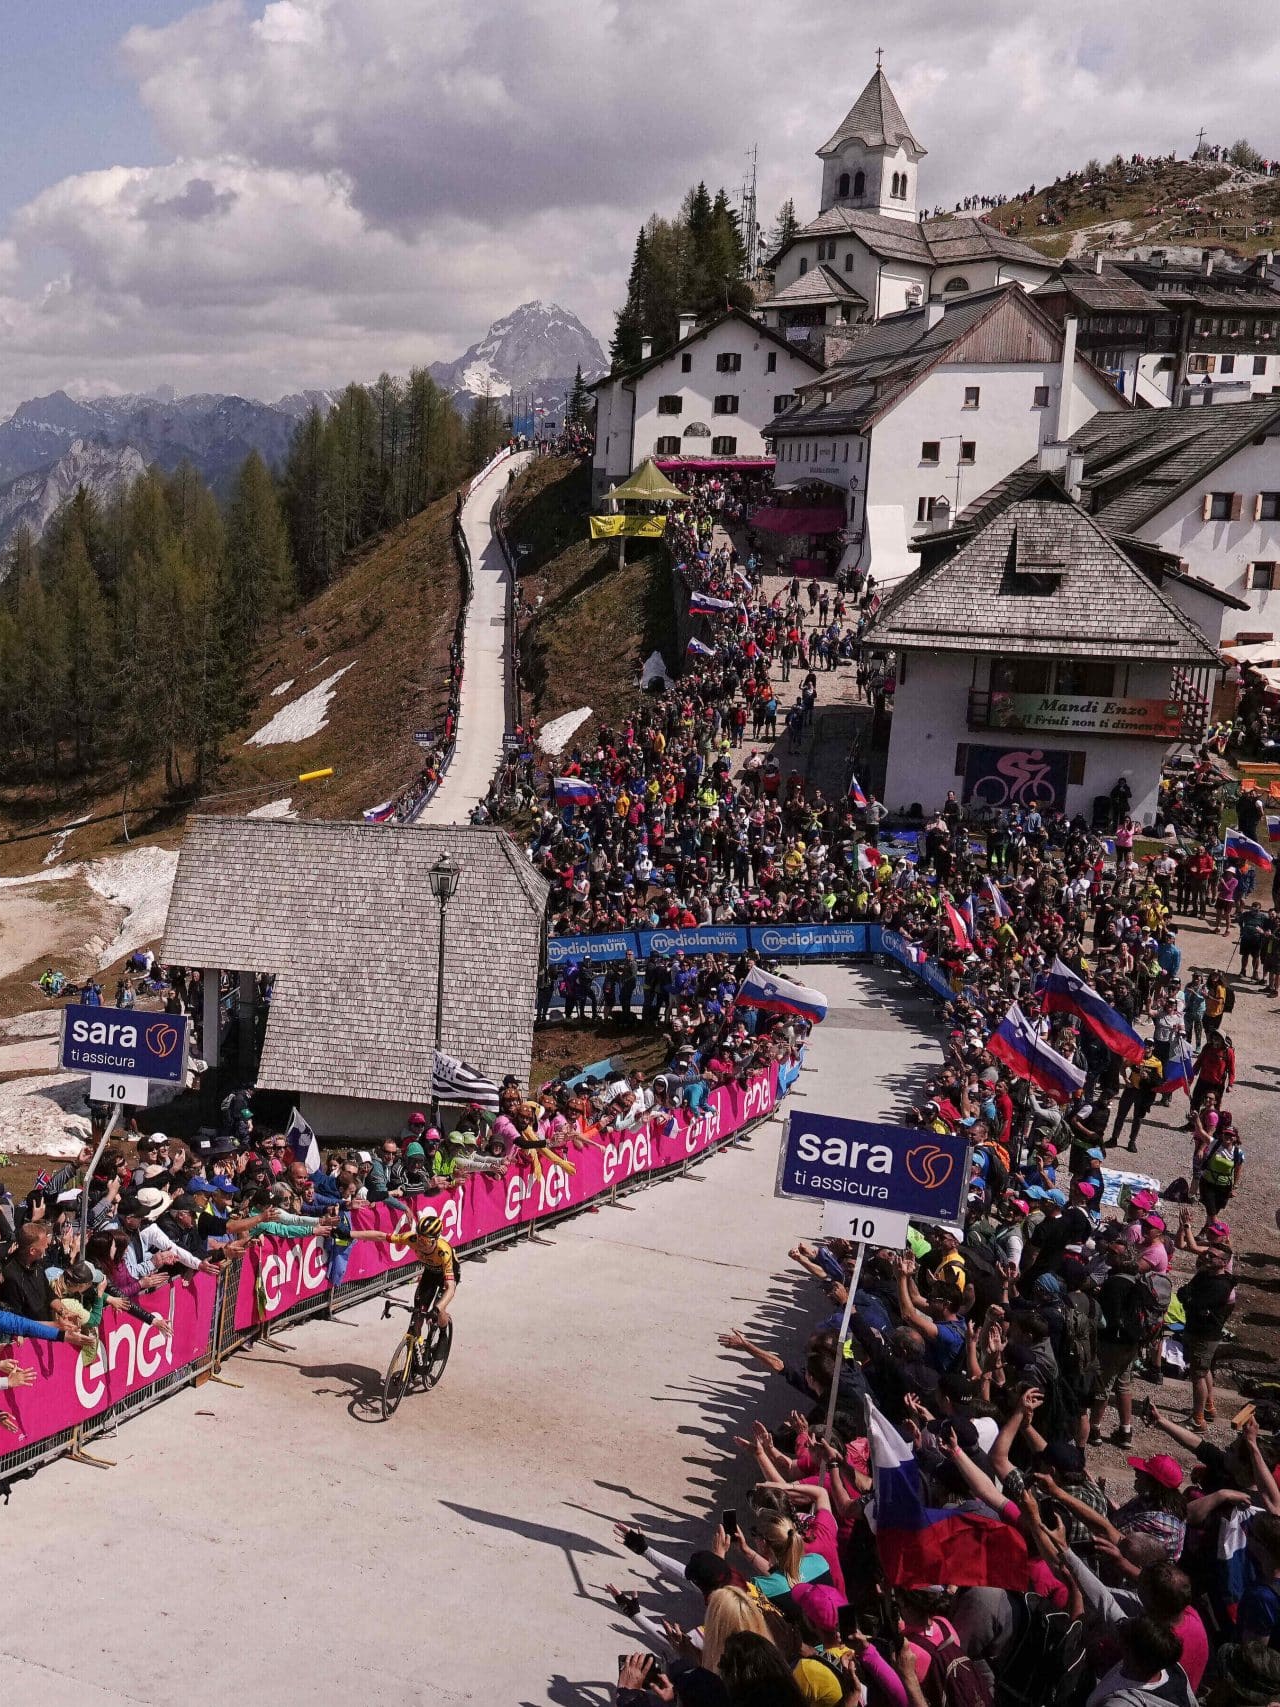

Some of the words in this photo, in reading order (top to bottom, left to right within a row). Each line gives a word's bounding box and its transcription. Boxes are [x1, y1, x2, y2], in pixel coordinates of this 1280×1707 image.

[1038, 699, 1099, 713] Mandi
[1102, 702, 1148, 717] Enzo
[1034, 714, 1070, 726] Friuli
[1072, 719, 1095, 727] non
[1099, 719, 1109, 728] ti
[548, 941, 627, 956] mediolanum
[654, 932, 737, 949] mediolanum
[765, 932, 855, 946] mediolanum
[72, 1020, 138, 1048] sara
[71, 1049, 80, 1061] ti
[82, 1052, 136, 1068] assicura
[108, 1084, 126, 1099] 10
[603, 1123, 653, 1184] enel
[796, 1133, 893, 1174] sara
[794, 1170, 807, 1185] ti
[810, 1175, 889, 1200] assicura
[849, 1217, 875, 1239] 10
[262, 1236, 328, 1312] ene
[75, 1287, 176, 1409] enel
